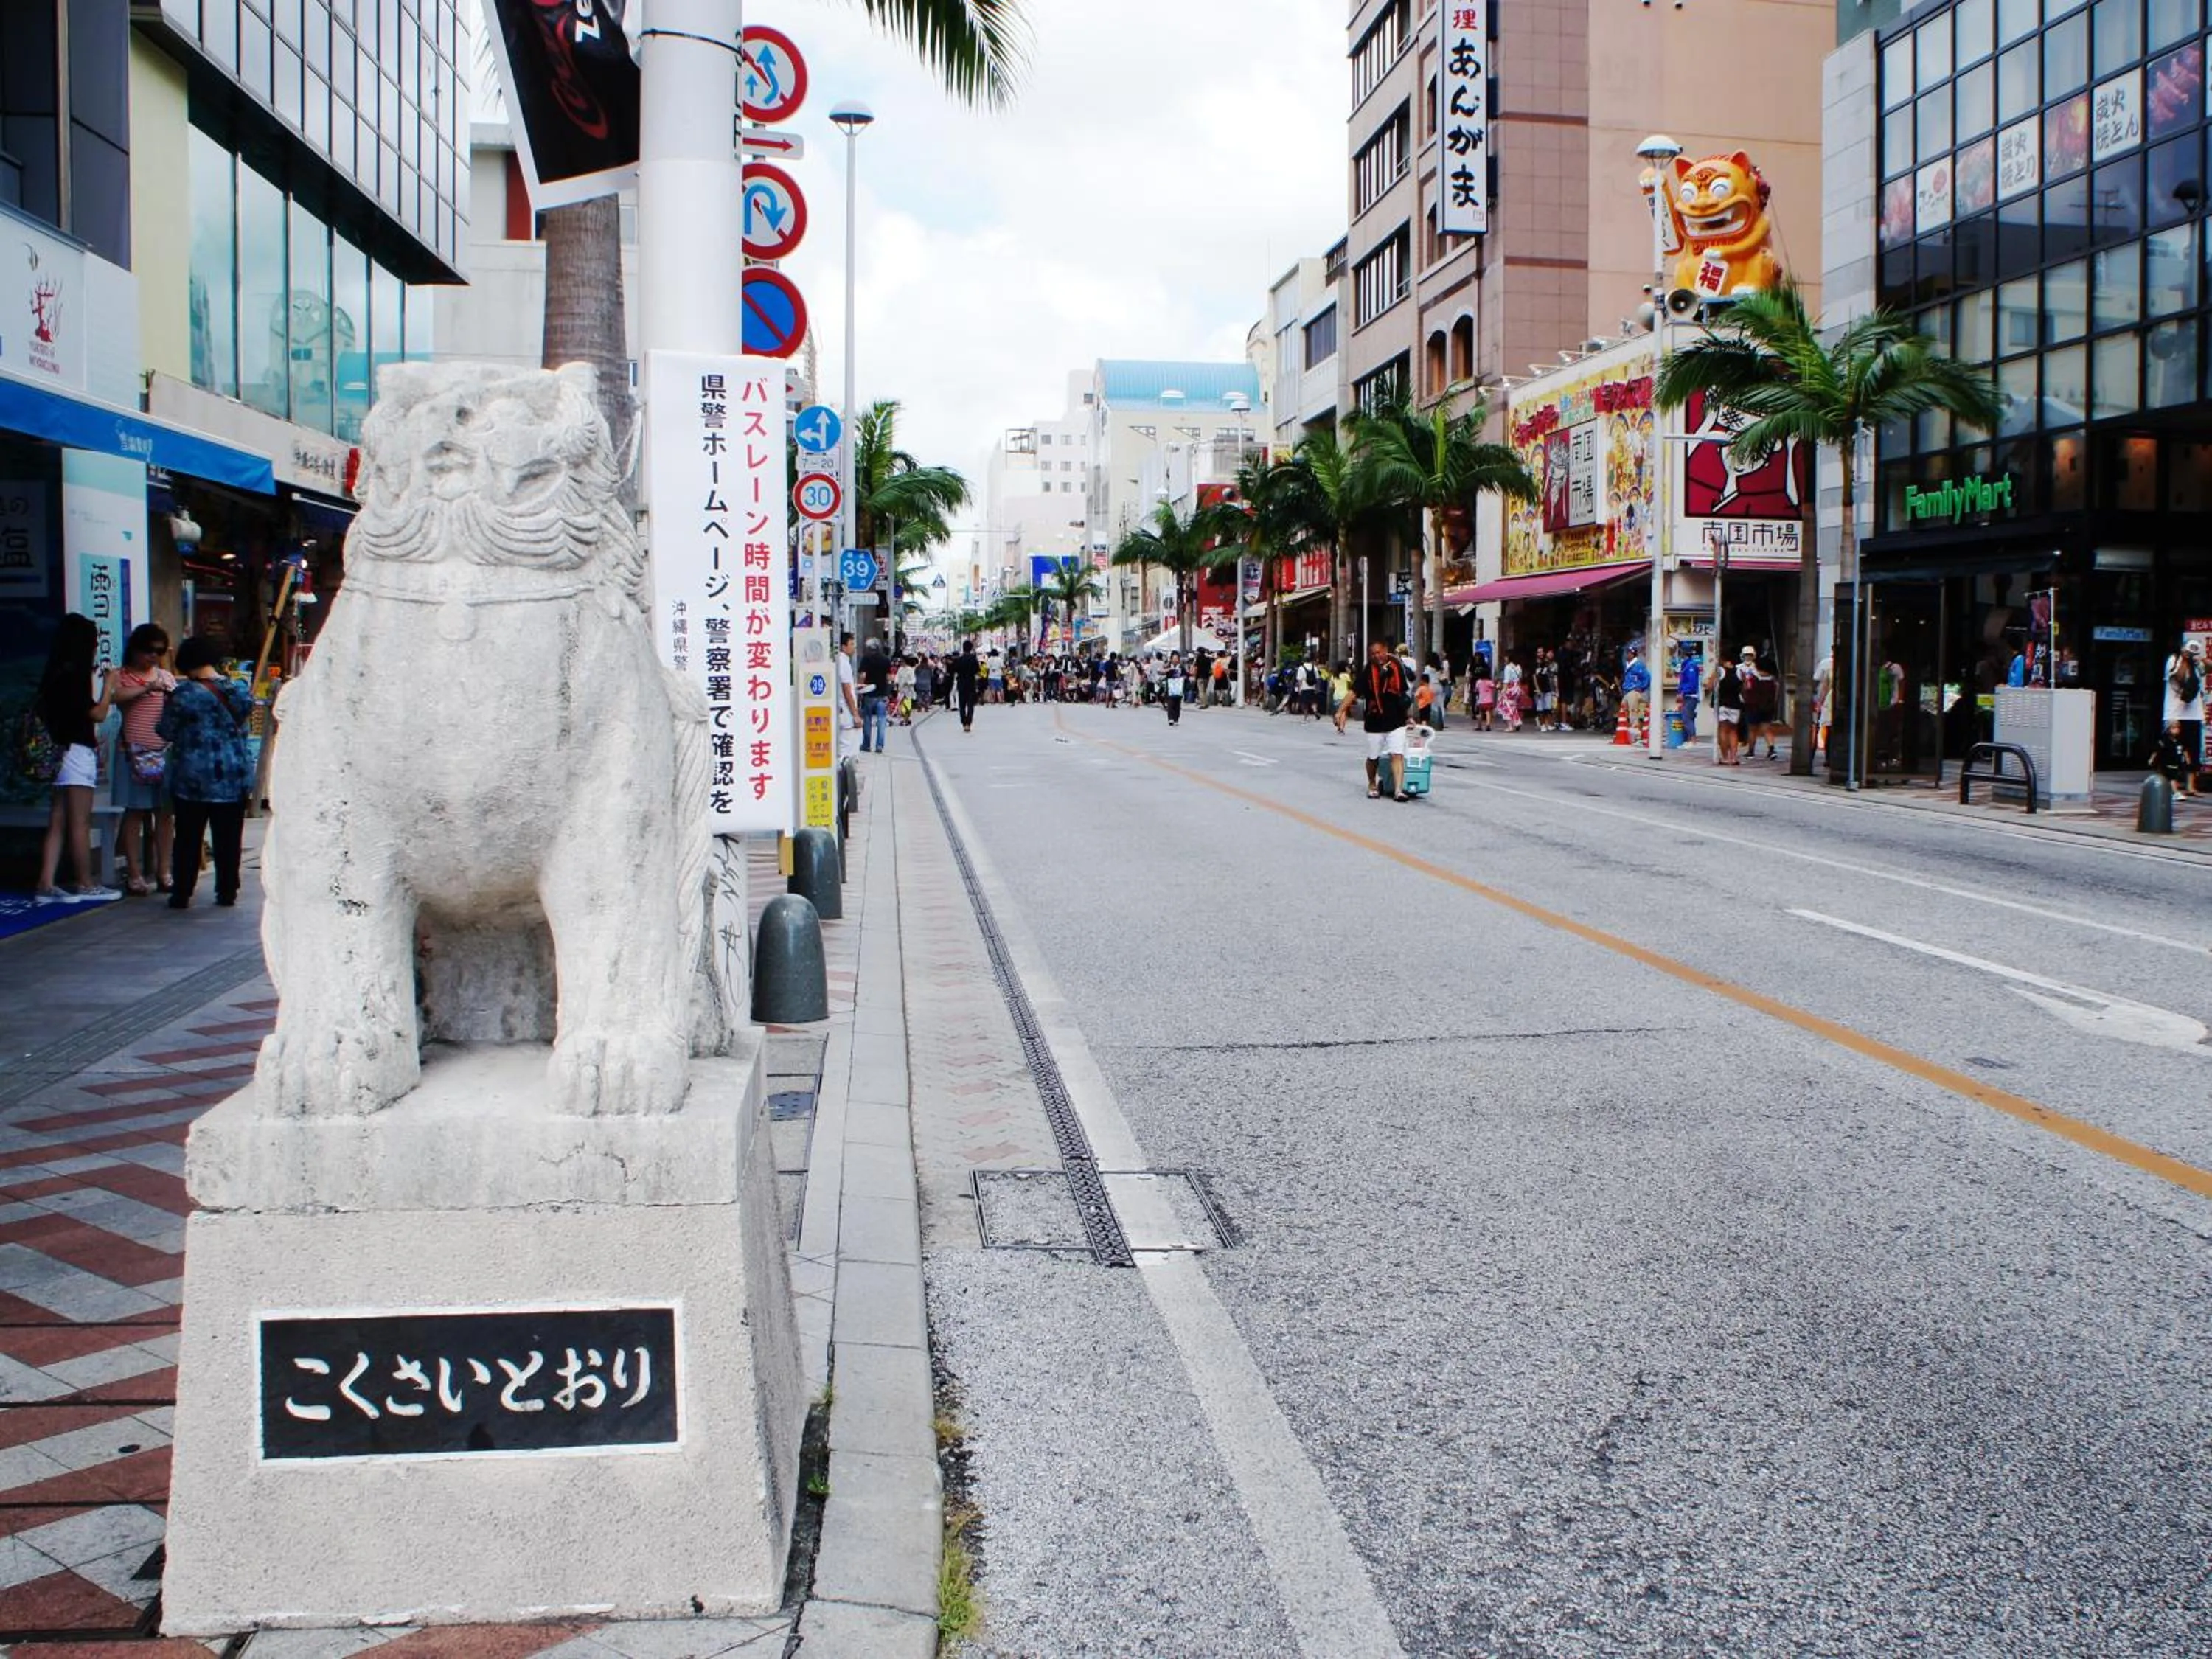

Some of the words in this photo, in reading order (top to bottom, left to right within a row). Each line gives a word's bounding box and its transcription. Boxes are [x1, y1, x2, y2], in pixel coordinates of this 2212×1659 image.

[1452, 0, 1478, 30] 理
[1448, 38, 1484, 207] あんがま
[1699, 261, 1725, 292] 福
[804, 486, 831, 507] 30
[1905, 472, 2012, 524] FamilyMart
[1703, 521, 1798, 552] 南国市場
[843, 560, 869, 577] 39
[742, 377, 773, 800] バスレーン時間が変わります
[812, 678, 824, 692] 39
[285, 1346, 652, 1420] こくさいとおり
